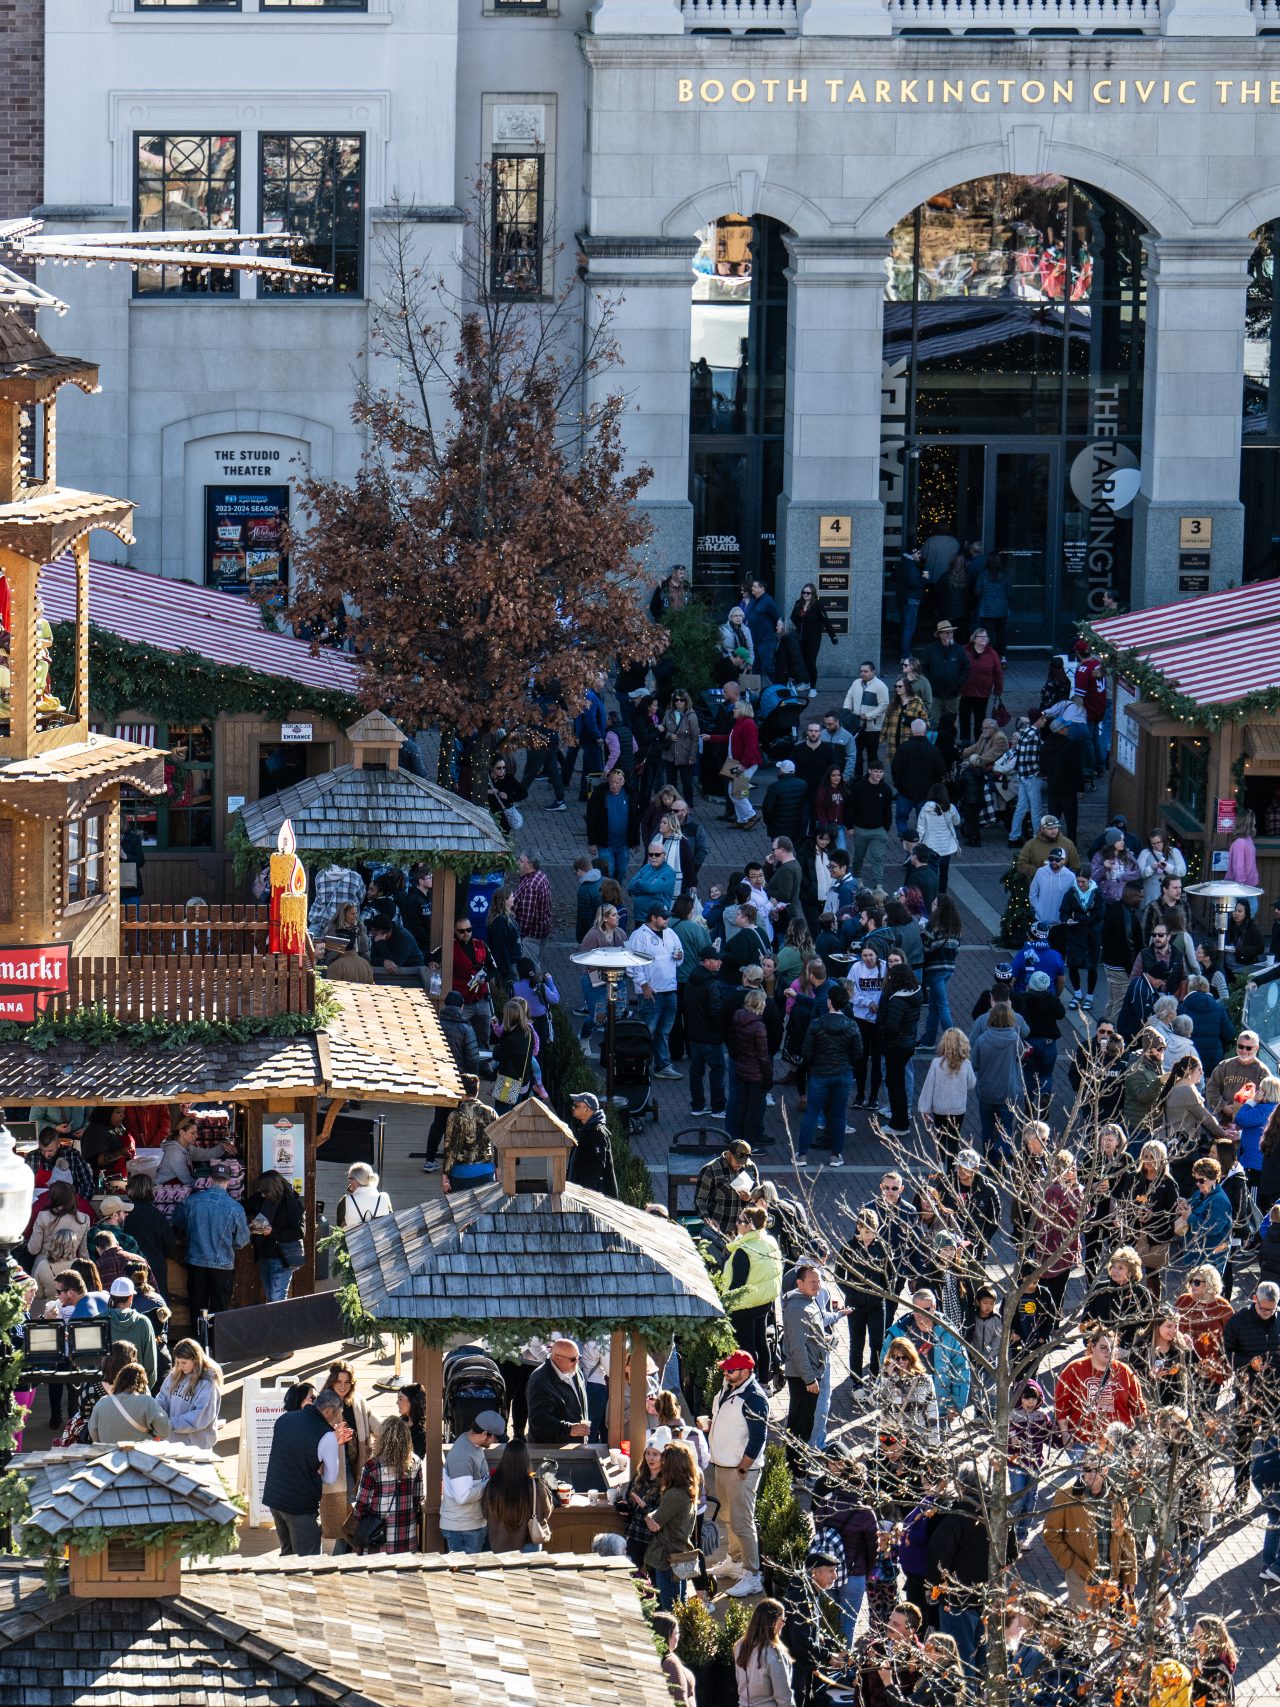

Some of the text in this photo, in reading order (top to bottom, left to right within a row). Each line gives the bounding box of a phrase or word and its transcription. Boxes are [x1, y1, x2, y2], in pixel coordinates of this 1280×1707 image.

[678, 78, 808, 103] BOOTH
[825, 79, 1074, 104] TARKINGTON
[1093, 80, 1196, 104] CIVIC
[214, 450, 280, 461] THE STUDIO
[223, 466, 272, 476] THEATER
[1088, 383, 1119, 619] THE TARKINGTO
[215, 505, 279, 513] 2023-2024 SEASON
[830, 519, 841, 533] 4
[1190, 520, 1202, 535] 3
[705, 535, 737, 544] STUDIO
[705, 543, 740, 552] THEATER
[821, 576, 846, 584] WorldTrips
[255, 1406, 284, 1414] Glühwein
